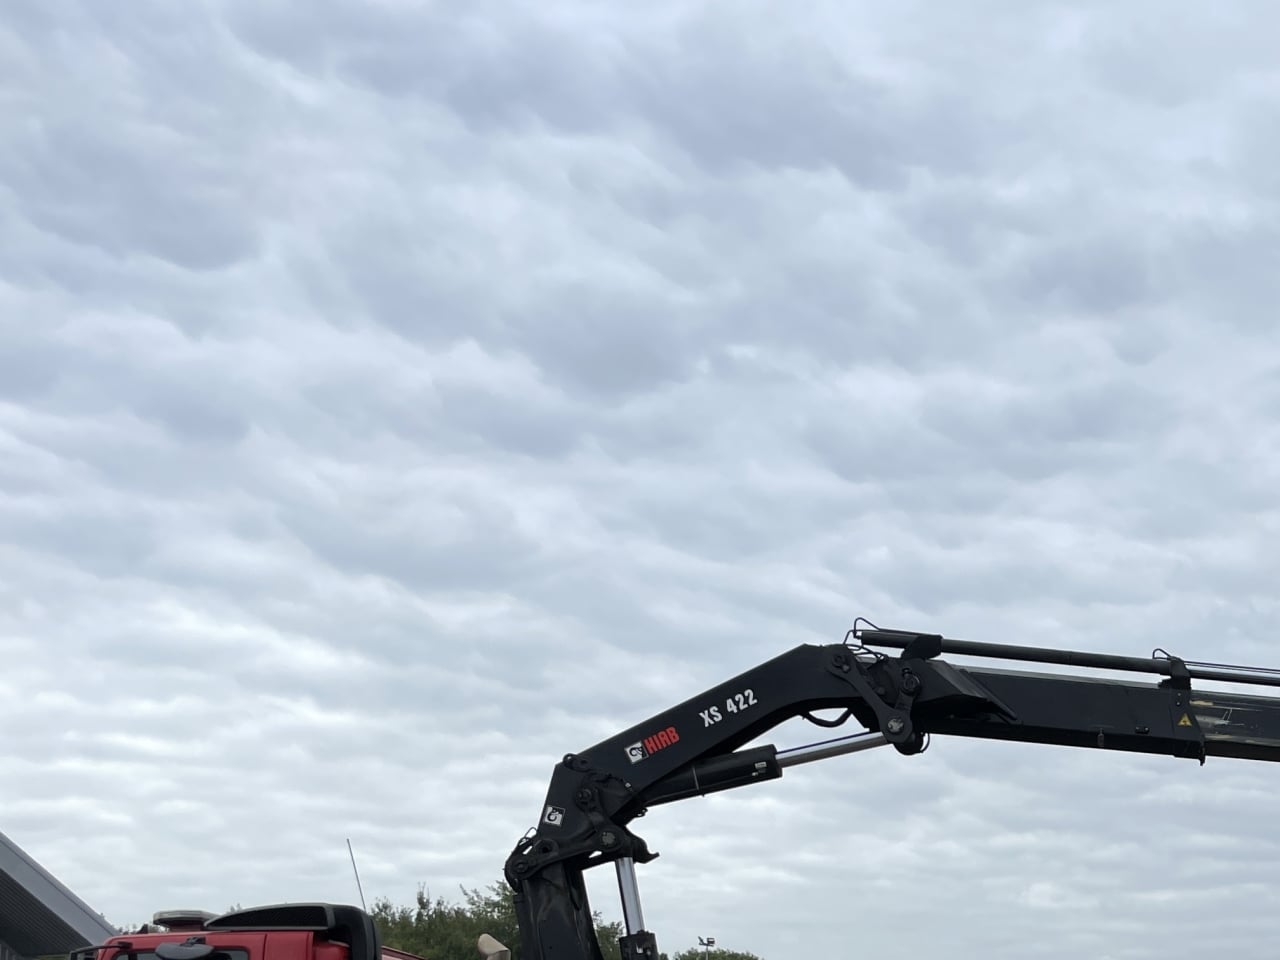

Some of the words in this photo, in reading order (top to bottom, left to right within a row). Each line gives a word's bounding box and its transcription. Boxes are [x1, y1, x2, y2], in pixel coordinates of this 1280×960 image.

[699, 706, 722, 728] XS
[726, 689, 758, 714] 422
[644, 726, 680, 754] HIAB
